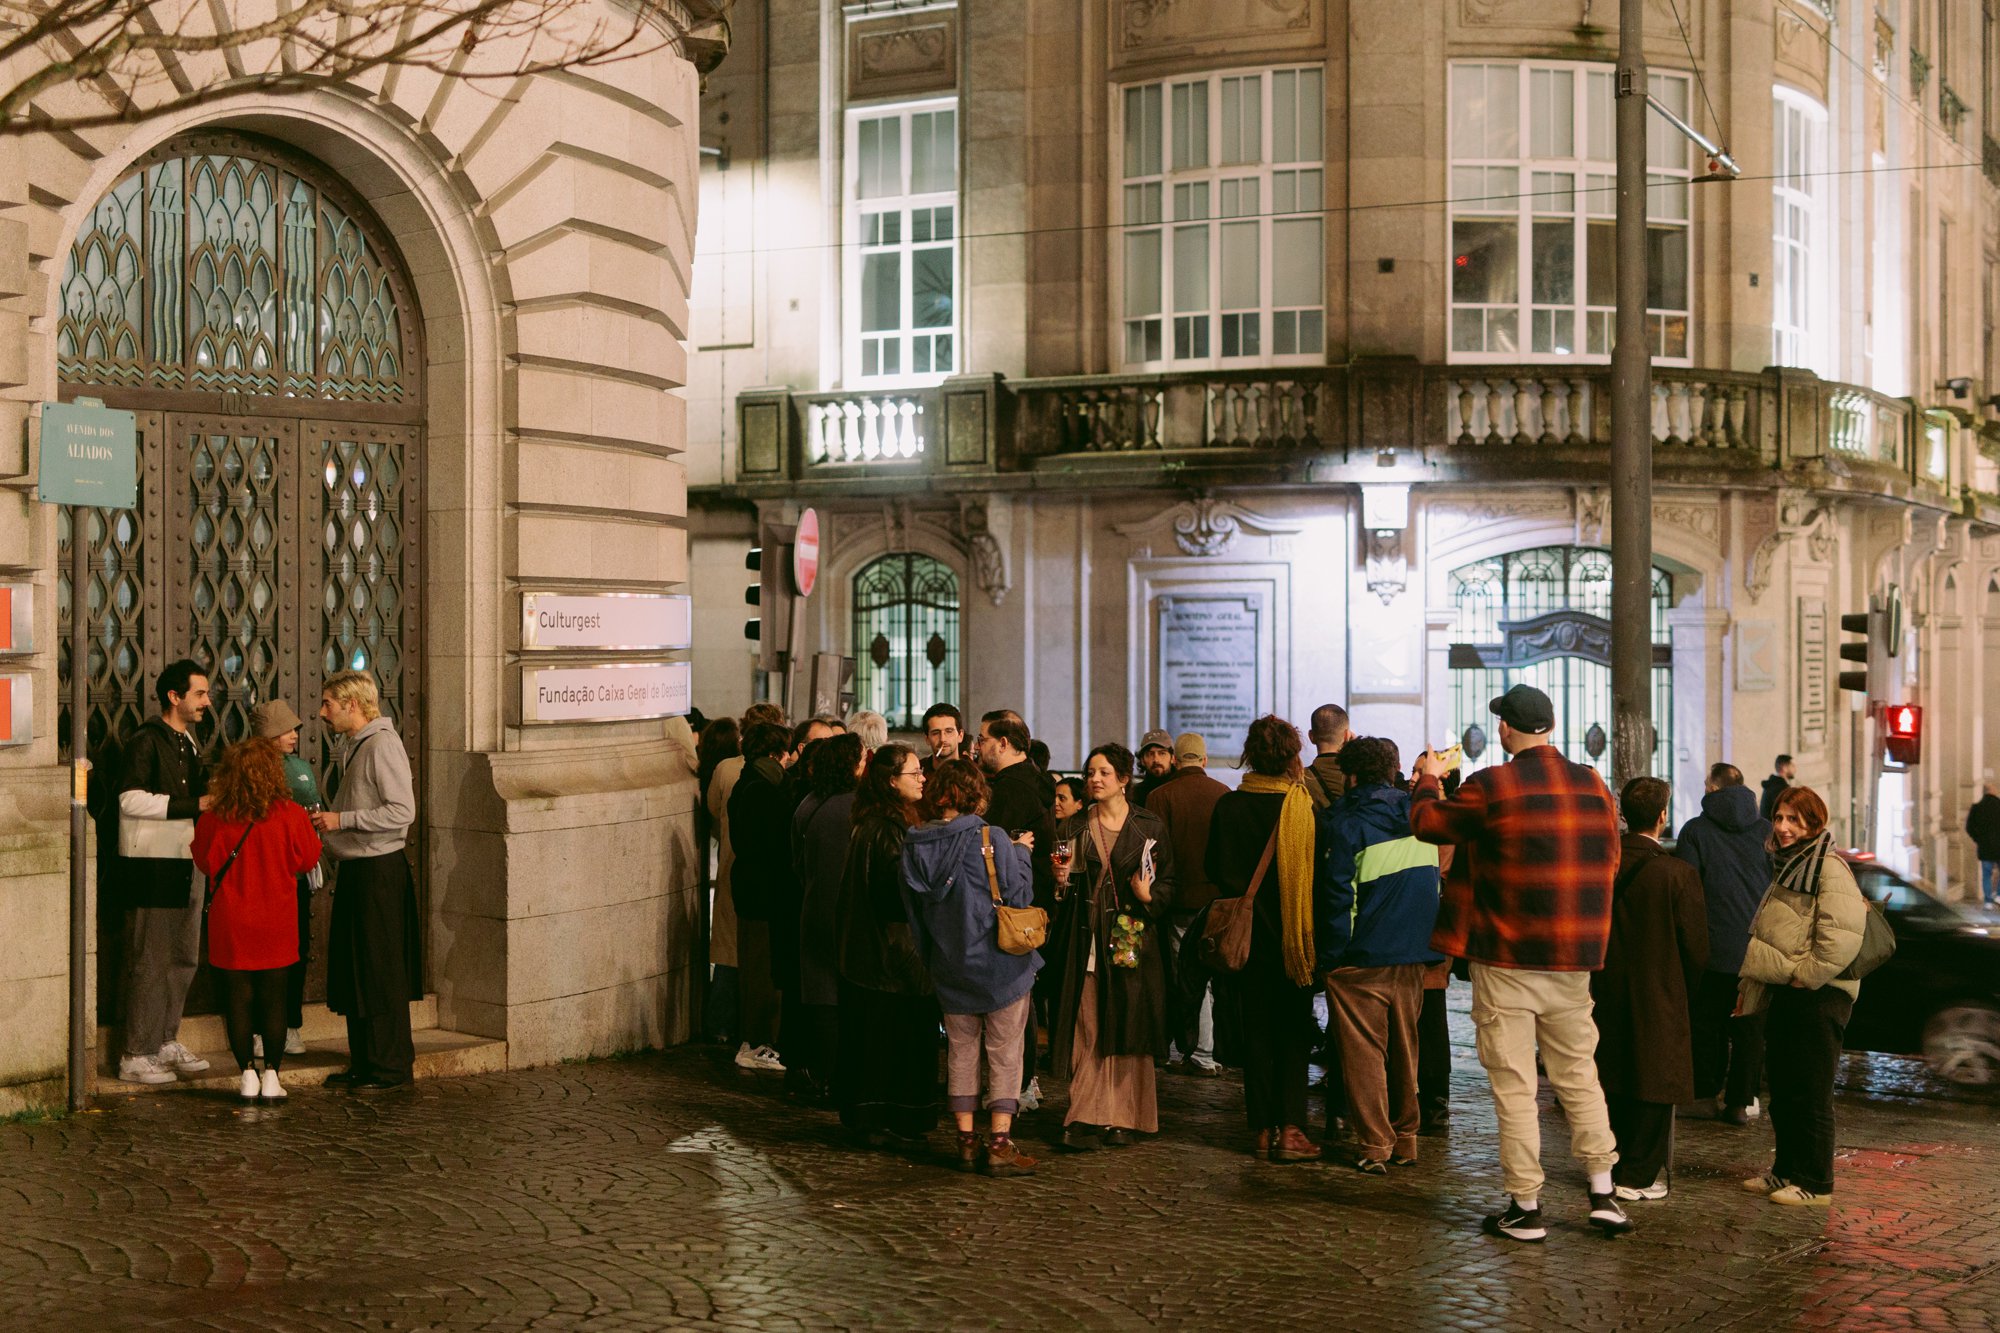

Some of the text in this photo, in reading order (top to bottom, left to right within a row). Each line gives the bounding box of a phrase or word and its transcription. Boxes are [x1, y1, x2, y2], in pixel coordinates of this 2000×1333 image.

[219, 392, 249, 416] 108
[66, 424, 114, 437] AVENIDA DOS
[67, 443, 113, 461] ALIADOS
[539, 611, 601, 632] Culturgest
[539, 685, 595, 706] Fundação
[598, 684, 625, 702] Caixa
[627, 683, 649, 700] Geral
[651, 683, 659, 699] de
